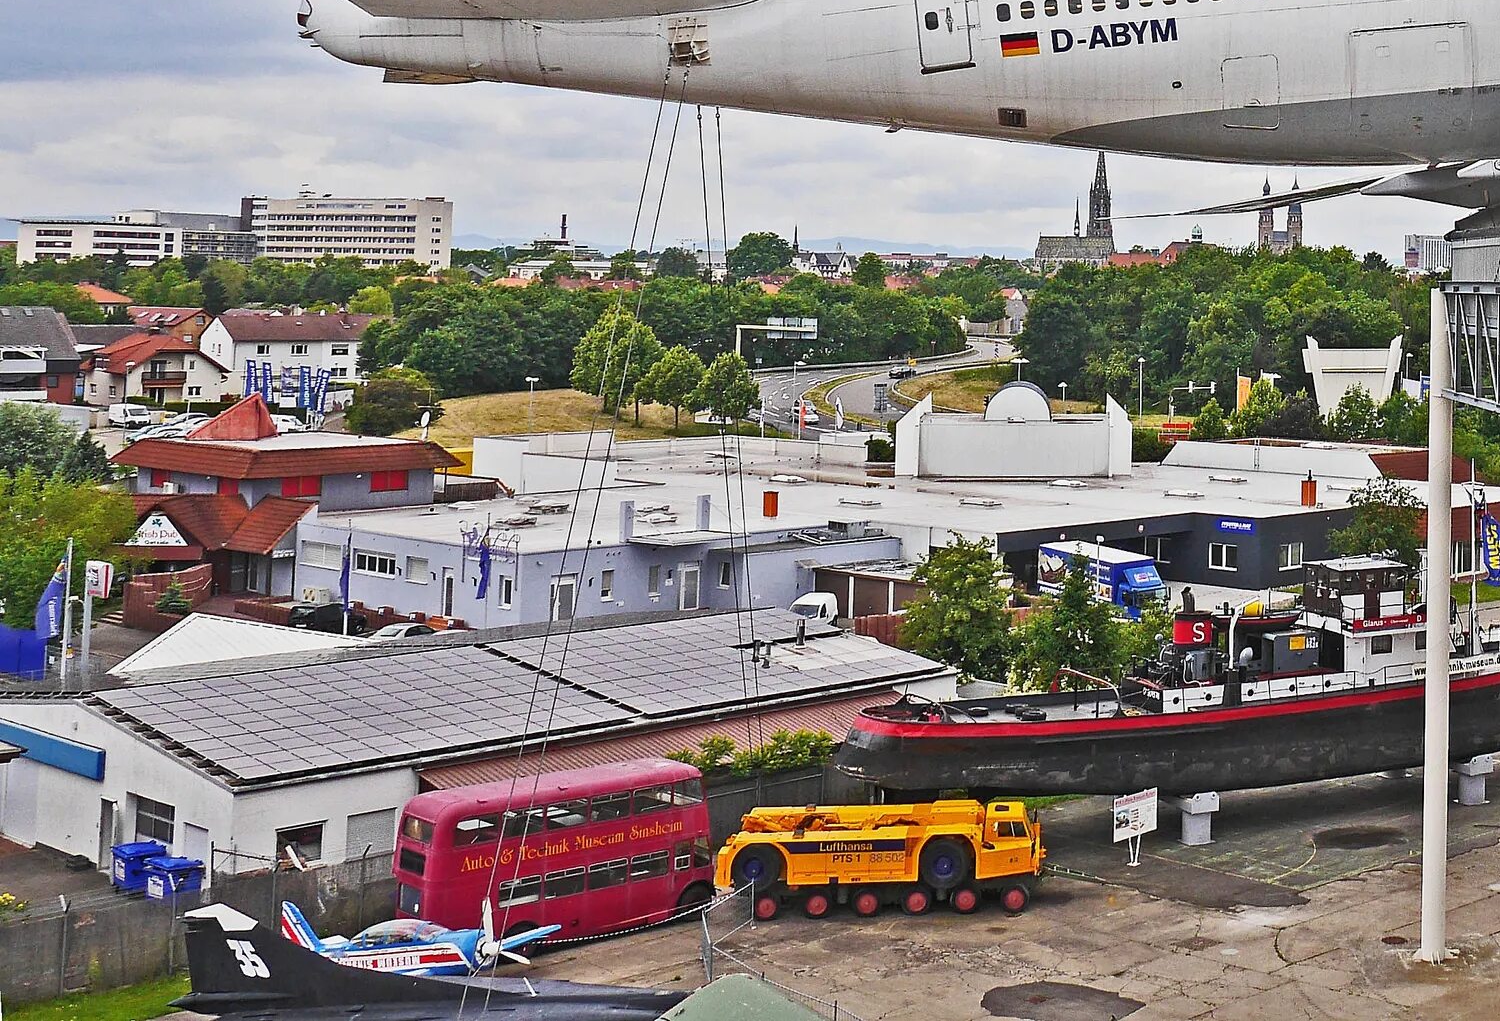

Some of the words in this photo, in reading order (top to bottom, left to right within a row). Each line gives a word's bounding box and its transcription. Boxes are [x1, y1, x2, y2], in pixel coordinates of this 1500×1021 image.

[1051, 18, 1178, 53] D-ABYM
[1192, 621, 1205, 642] S
[1362, 619, 1384, 628] Glarus
[461, 856, 495, 873] Auto
[500, 848, 515, 864] &
[520, 841, 569, 861] Technik
[575, 832, 624, 851] Museum
[629, 820, 684, 841] Sinsheim
[819, 842, 873, 852] Lufthansa
[832, 853, 853, 863] PTS
[855, 853, 861, 863] 1
[226, 939, 270, 978] 35
